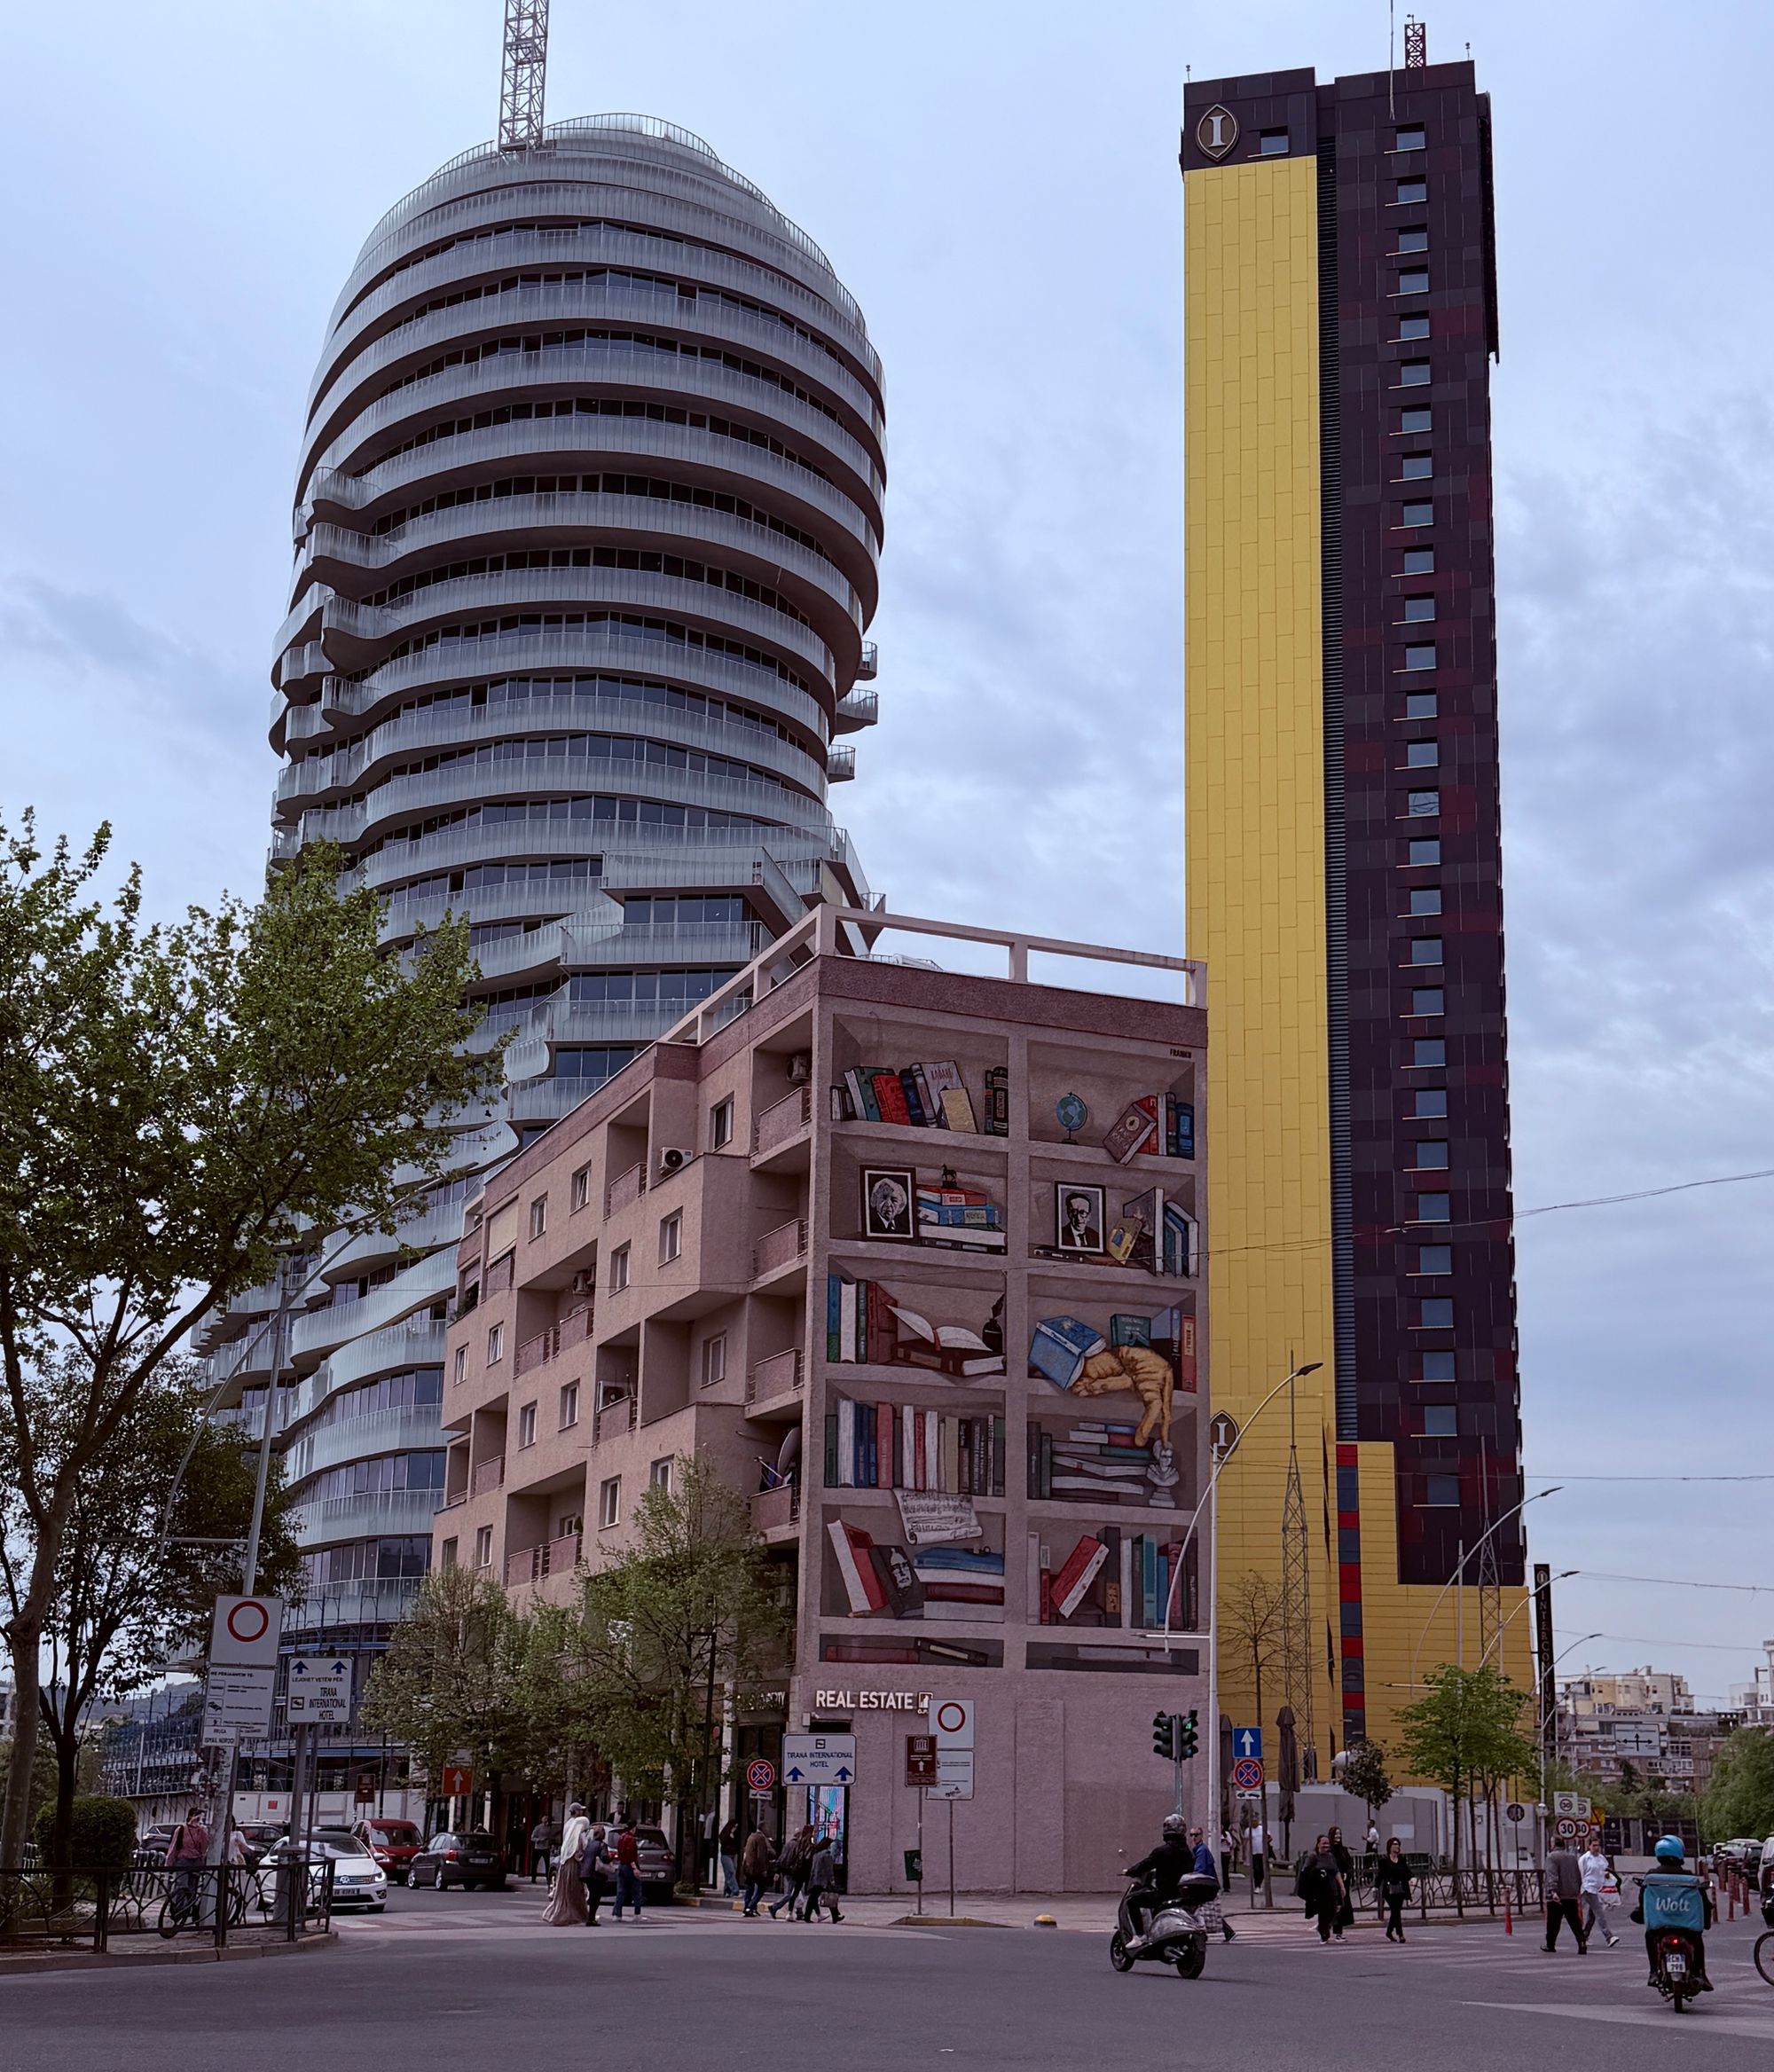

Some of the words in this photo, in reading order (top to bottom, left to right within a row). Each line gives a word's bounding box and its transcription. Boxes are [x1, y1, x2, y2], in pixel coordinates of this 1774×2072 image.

[1208, 114, 1227, 148] I
[1216, 1422, 1229, 1447] I
[816, 1690, 855, 1708] REAL
[860, 1691, 914, 1709] ESTATE
[1561, 1824, 1574, 1833] 30
[1656, 1897, 1690, 1911] Wolt
